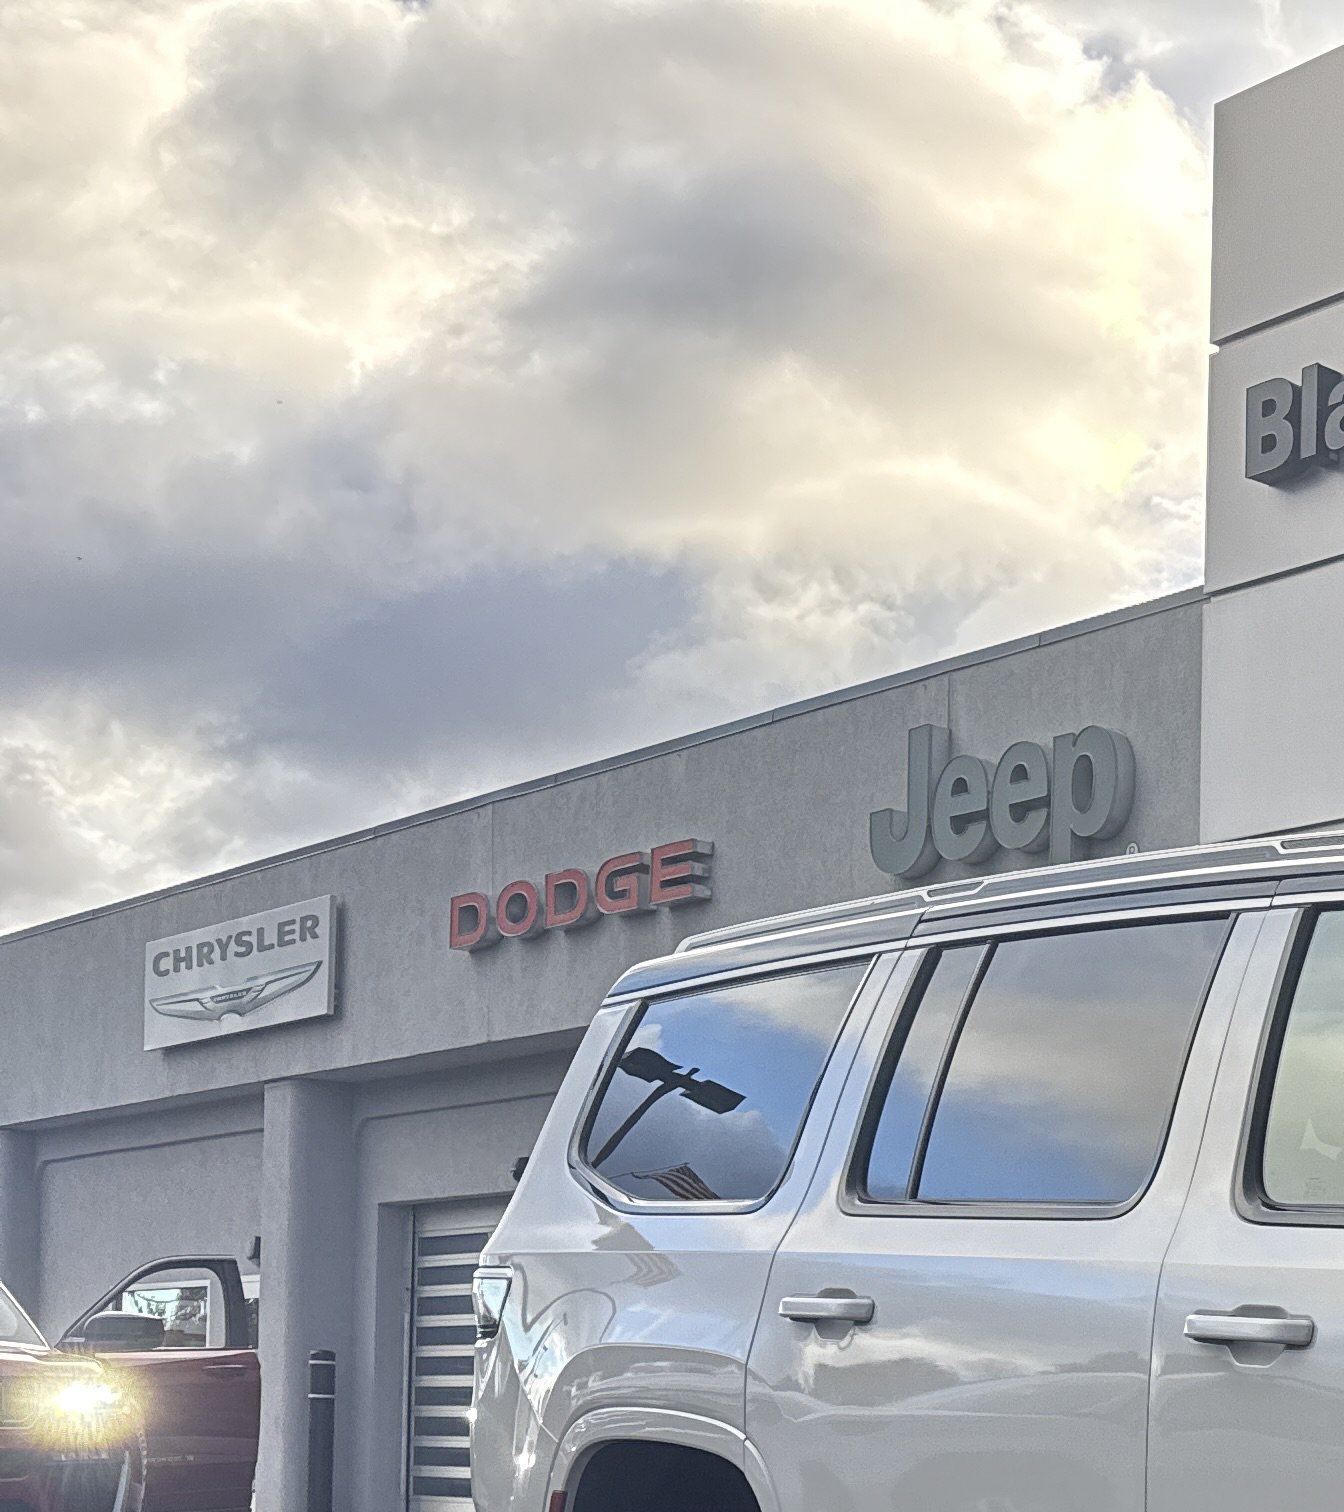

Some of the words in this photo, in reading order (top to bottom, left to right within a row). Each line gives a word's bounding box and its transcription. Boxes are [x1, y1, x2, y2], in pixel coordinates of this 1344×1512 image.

[869, 723, 1133, 876] Jeep
[152, 914, 319, 977] CHRYSLER
[449, 838, 711, 949] DODGE
